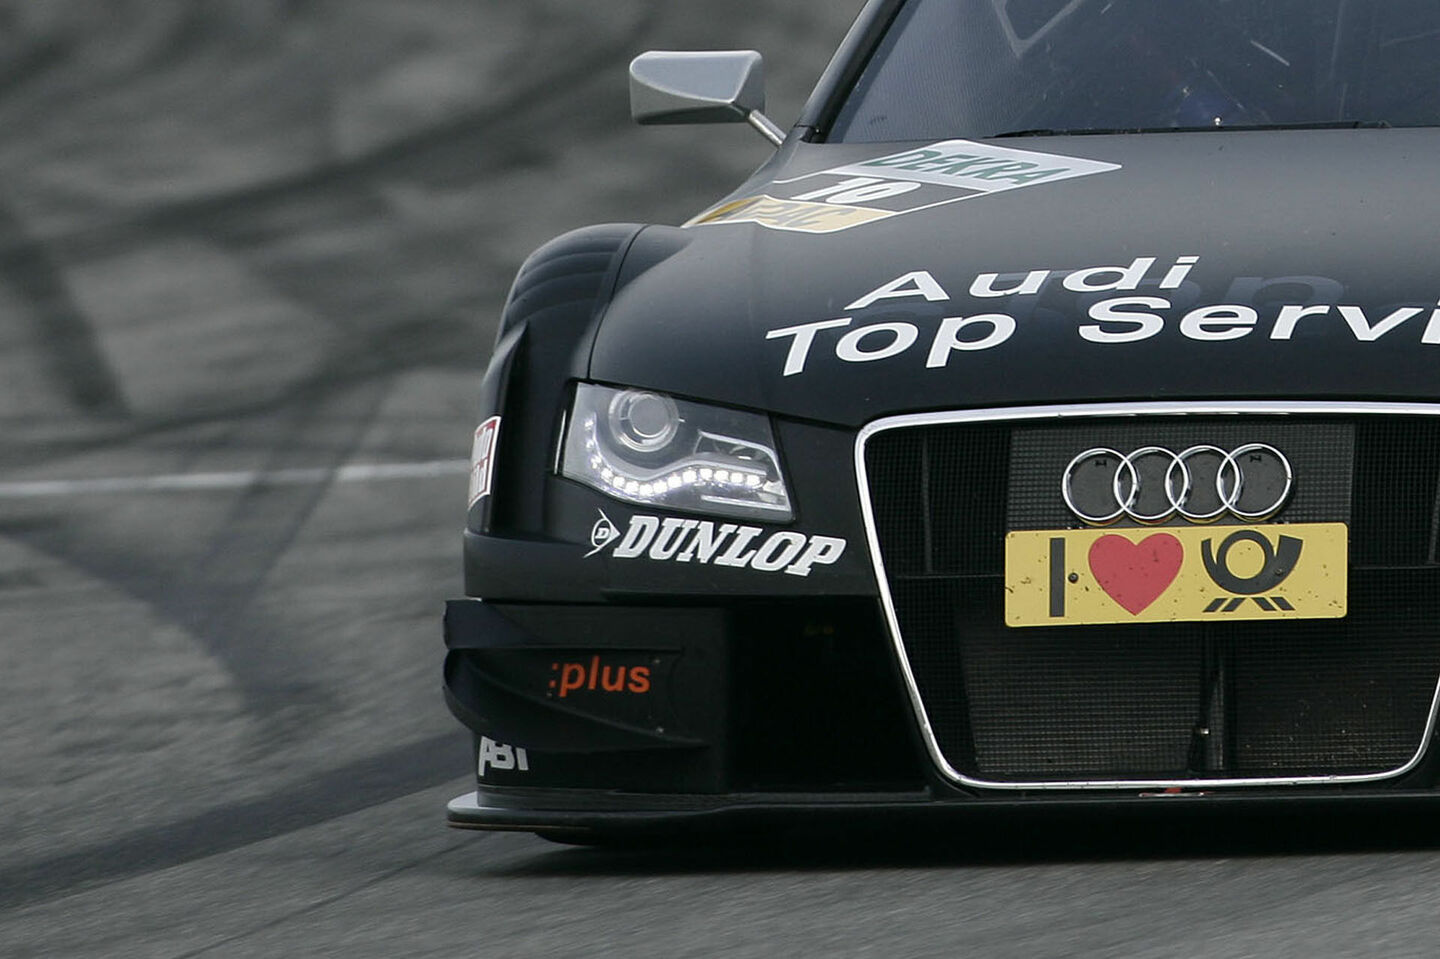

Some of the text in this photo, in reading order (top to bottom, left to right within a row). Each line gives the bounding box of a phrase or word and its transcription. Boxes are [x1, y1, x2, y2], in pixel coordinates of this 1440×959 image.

[789, 177, 921, 204] 10
[862, 150, 1070, 183] DEKRA
[844, 256, 1200, 310] Audi
[765, 313, 1017, 377] Top
[613, 515, 846, 577] DUNLOP
[1049, 537, 1066, 618] I
